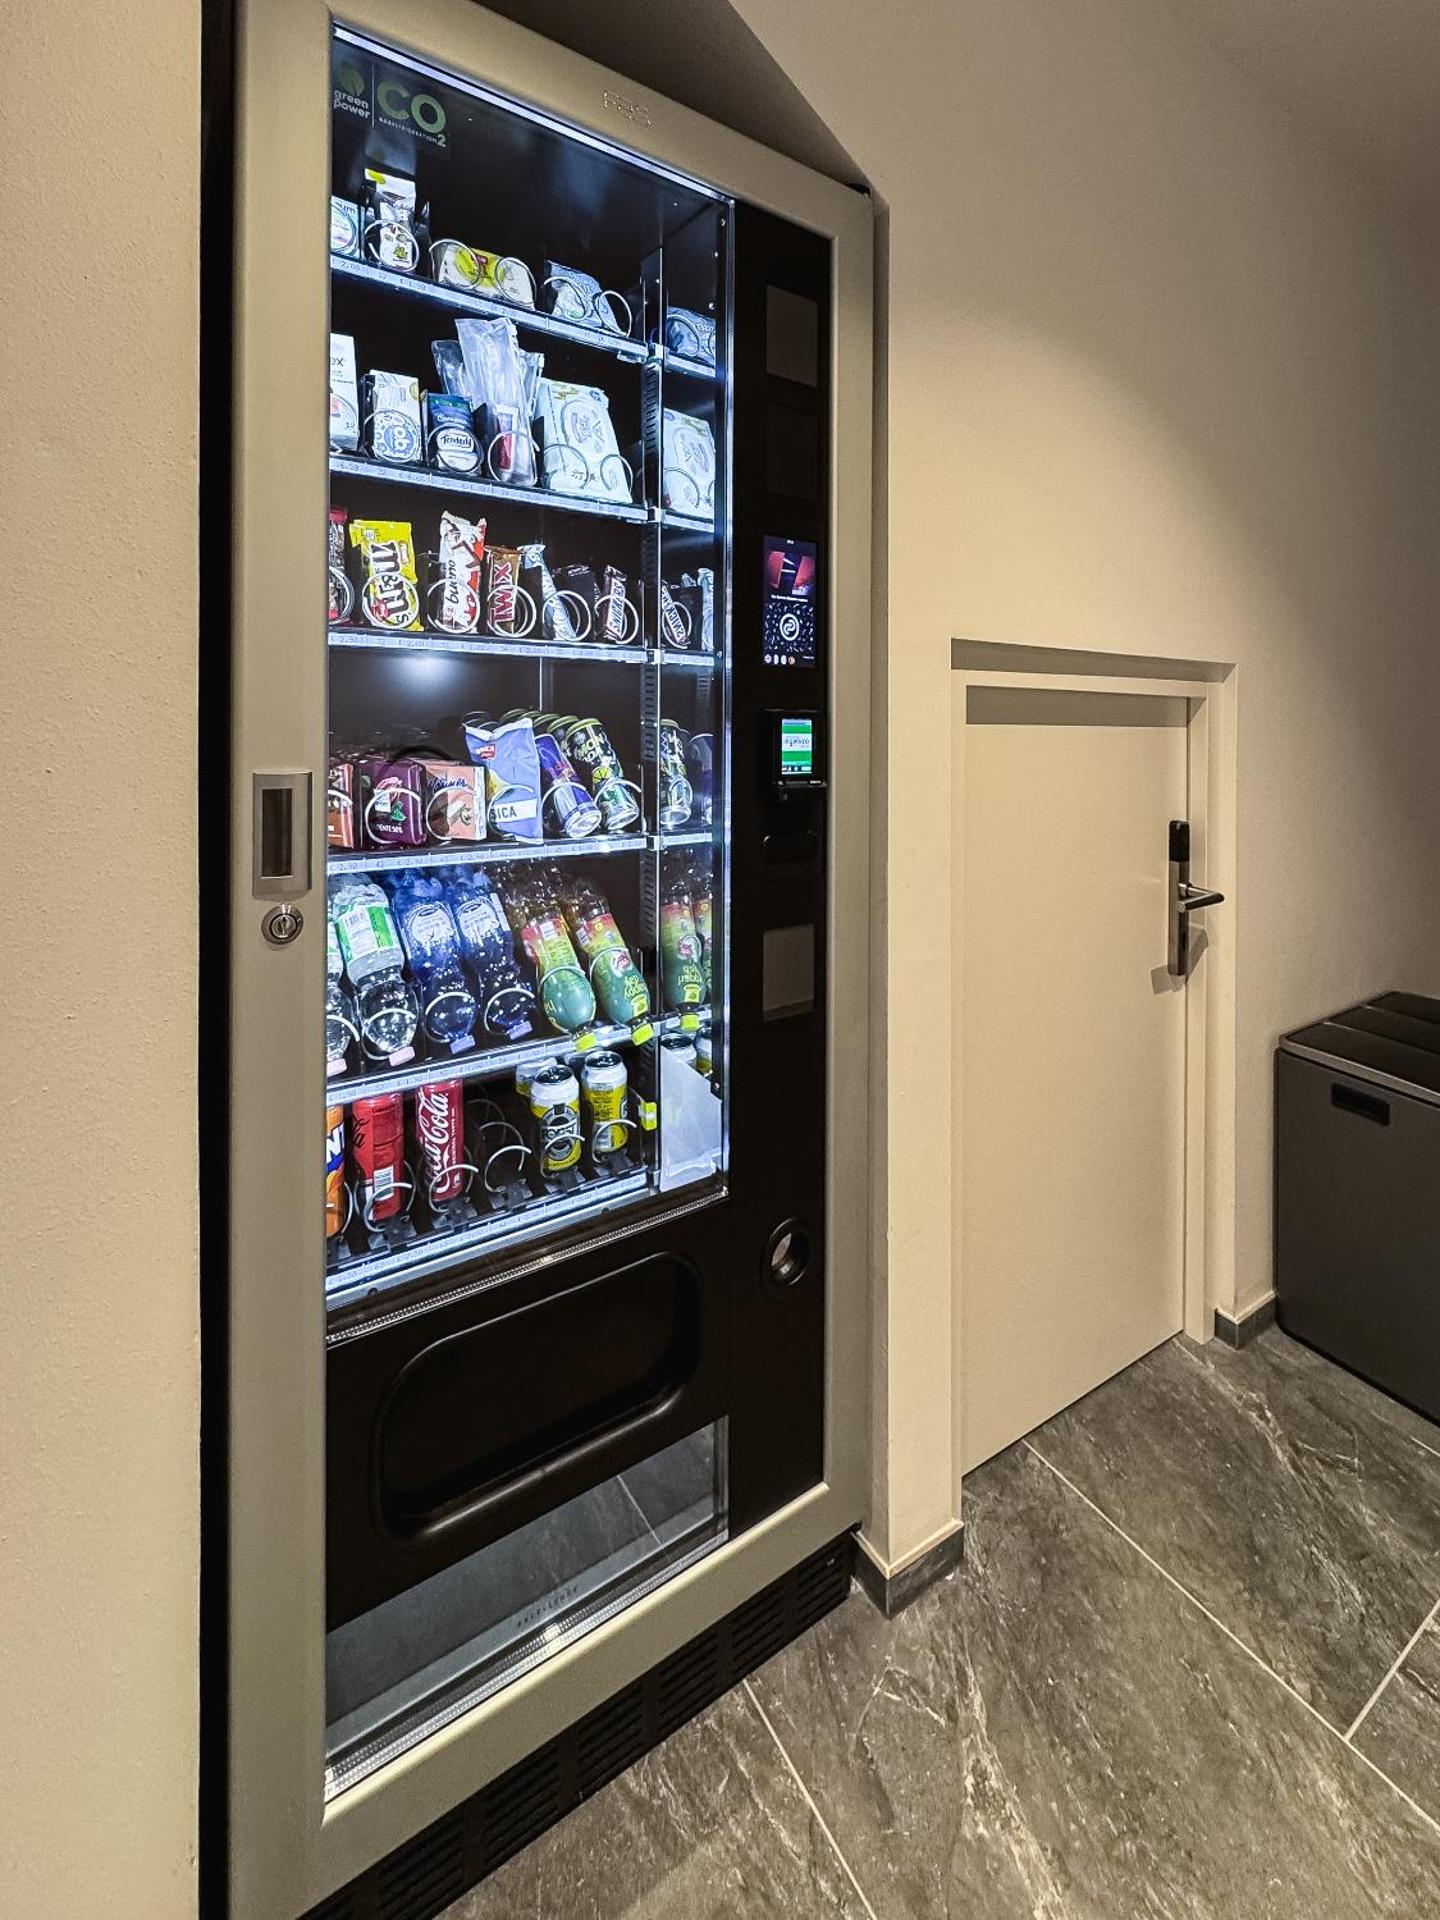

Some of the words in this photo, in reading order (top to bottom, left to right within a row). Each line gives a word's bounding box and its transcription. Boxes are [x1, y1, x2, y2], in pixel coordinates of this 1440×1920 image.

[333, 100, 371, 119] power
[334, 91, 369, 109] green
[445, 559, 459, 605] bueno
